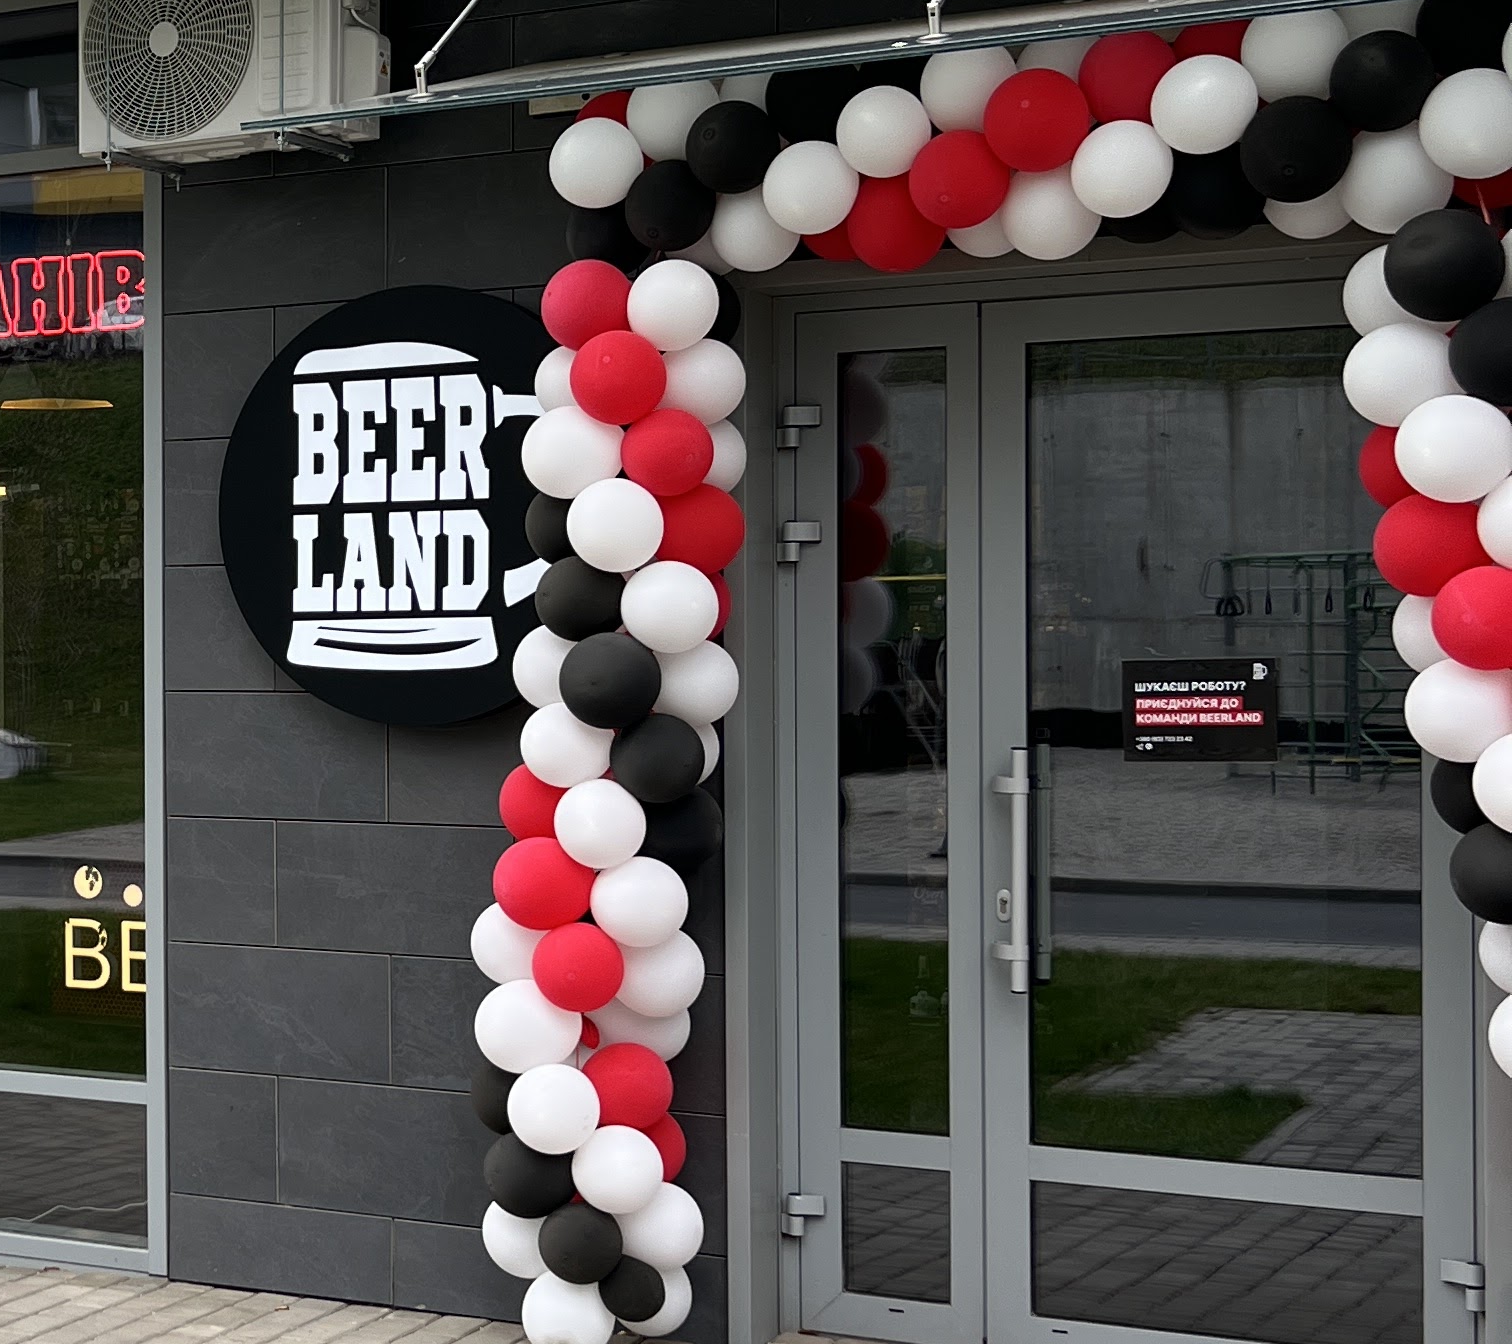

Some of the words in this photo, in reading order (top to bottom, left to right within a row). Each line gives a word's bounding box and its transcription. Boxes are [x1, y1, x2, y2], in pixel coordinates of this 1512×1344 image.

[292, 373, 490, 506] BEER
[292, 508, 491, 613] LAND
[1134, 681, 1189, 693] ШУКАЄШ
[1191, 680, 1246, 692] РОБОТУ?
[1136, 697, 1218, 710] ПРИЄДНУЙСЯ
[1220, 698, 1239, 710] ДО
[1136, 712, 1197, 725] КОМАНДИ
[1199, 712, 1261, 723] BEERLAND
[64, 917, 147, 993] BE
